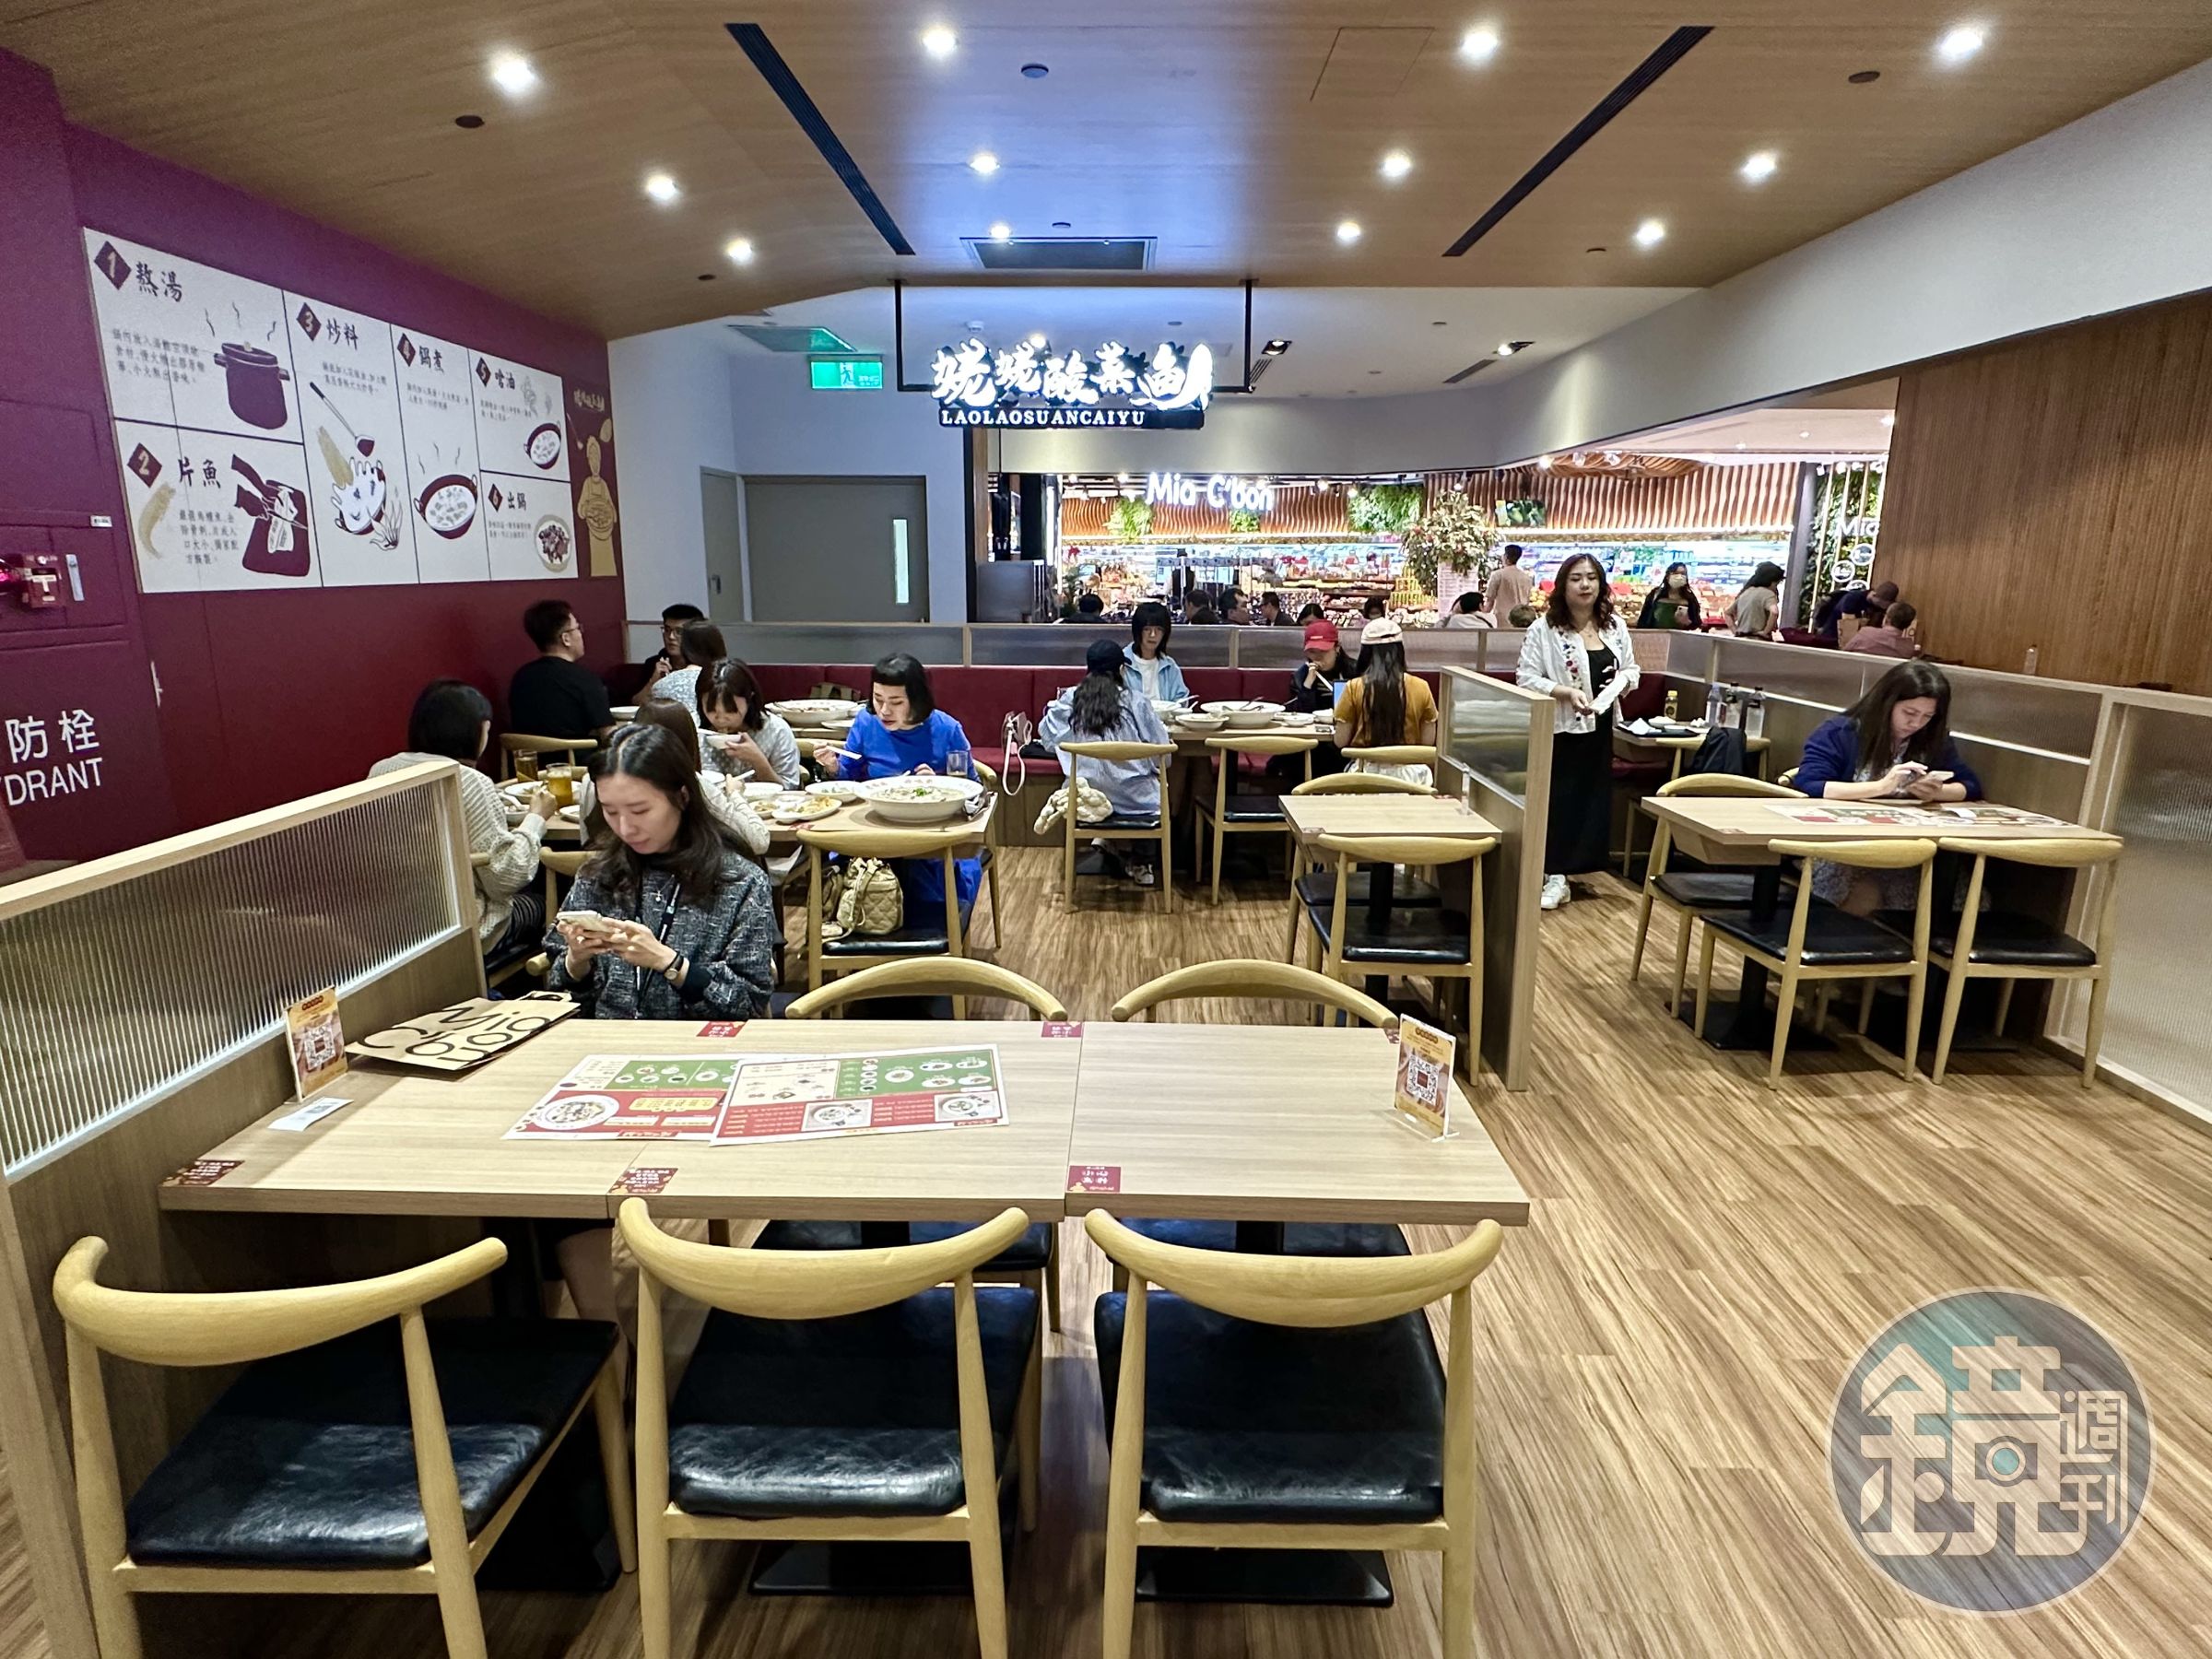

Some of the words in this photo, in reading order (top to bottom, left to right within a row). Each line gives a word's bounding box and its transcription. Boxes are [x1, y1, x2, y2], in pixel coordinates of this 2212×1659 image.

[107, 251, 118, 278] 1
[135, 261, 182, 302] 熬湯
[305, 312, 313, 333] 3
[326, 318, 359, 350] 炒料
[480, 363, 487, 381] 5
[941, 410, 1146, 426] LAOLAOSUANCAIYU
[138, 450, 150, 476] 2
[178, 455, 221, 489] 片魚
[1145, 471, 1196, 507] Mia
[5, 709, 100, 764] 防栓
[0, 757, 103, 806] DRANT
